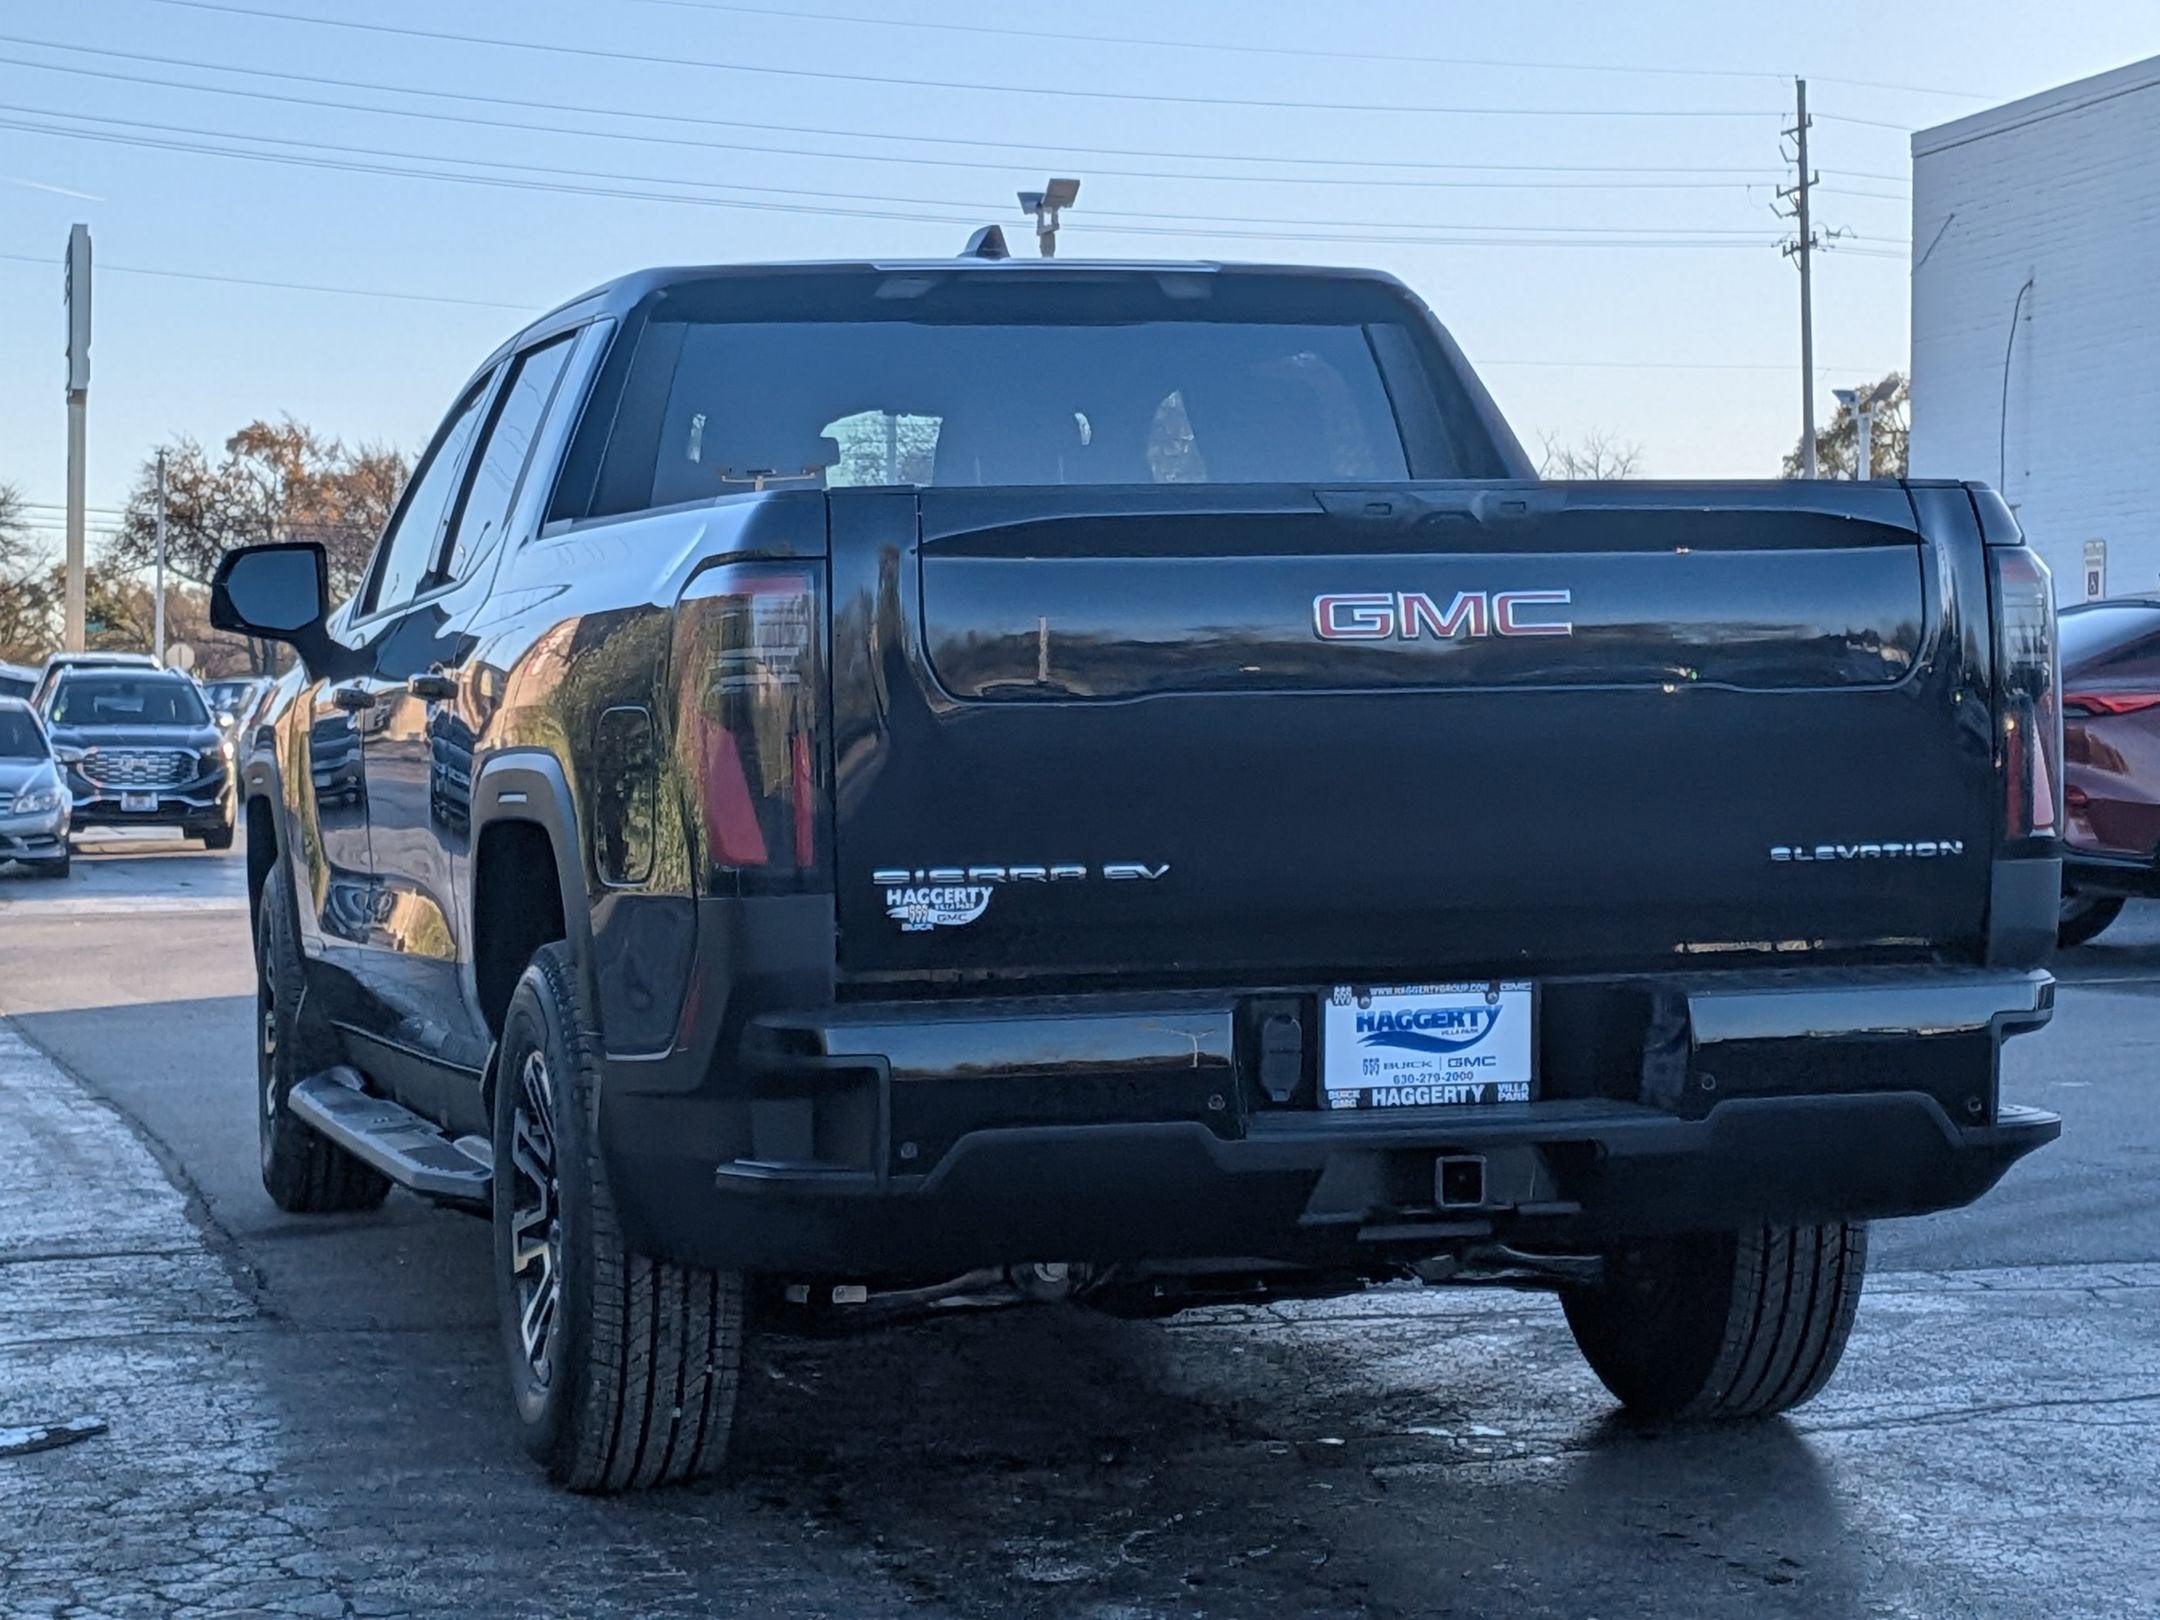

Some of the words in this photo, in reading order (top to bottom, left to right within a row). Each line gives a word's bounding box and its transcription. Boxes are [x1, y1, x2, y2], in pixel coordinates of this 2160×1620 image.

[1313, 589, 1573, 640] GMC
[1770, 841, 1963, 861] ELEVATION
[873, 866, 1087, 884] SIERRA
[1103, 864, 1170, 880] EV
[887, 887, 993, 905] HAGGERTY
[1356, 1004, 1503, 1032] HAGGERTY
[1384, 1061, 1432, 1070] BUICK
[1448, 1056, 1496, 1068] GMC
[1393, 1071, 1474, 1085] 630-279-2000
[1497, 1082, 1529, 1092] VILLA
[1372, 1085, 1485, 1107] HAGGERTY
[1497, 1092, 1529, 1102] PARK
